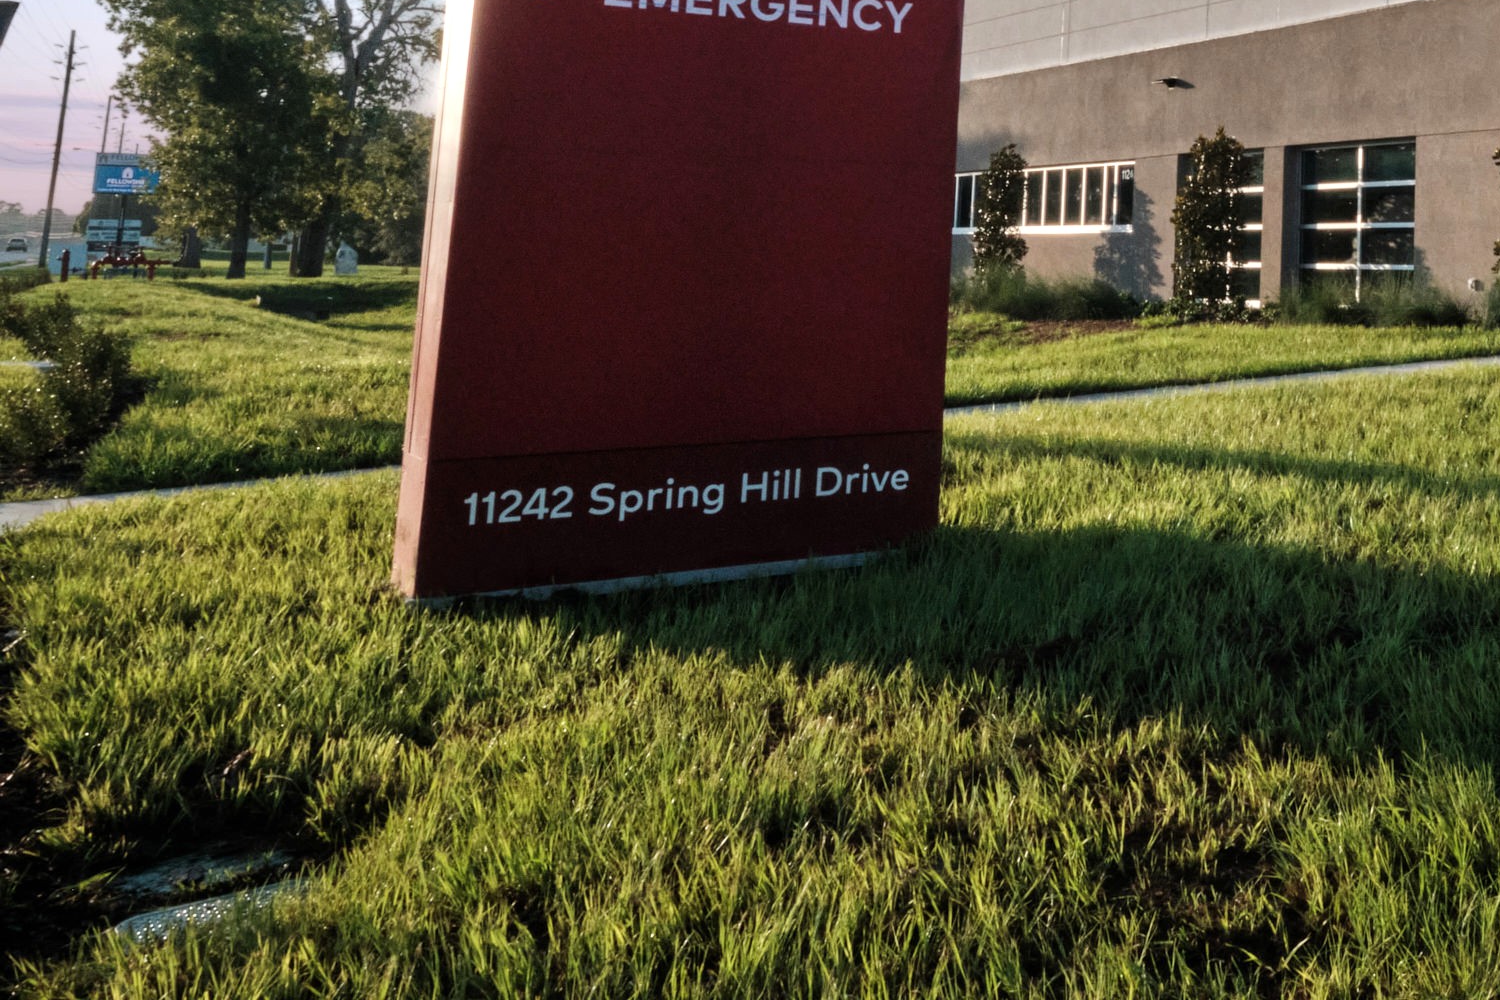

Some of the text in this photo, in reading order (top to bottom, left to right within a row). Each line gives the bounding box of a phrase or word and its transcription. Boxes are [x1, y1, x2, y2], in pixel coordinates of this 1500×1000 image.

[464, 463, 910, 526] 11242 Spring Hill Drive
